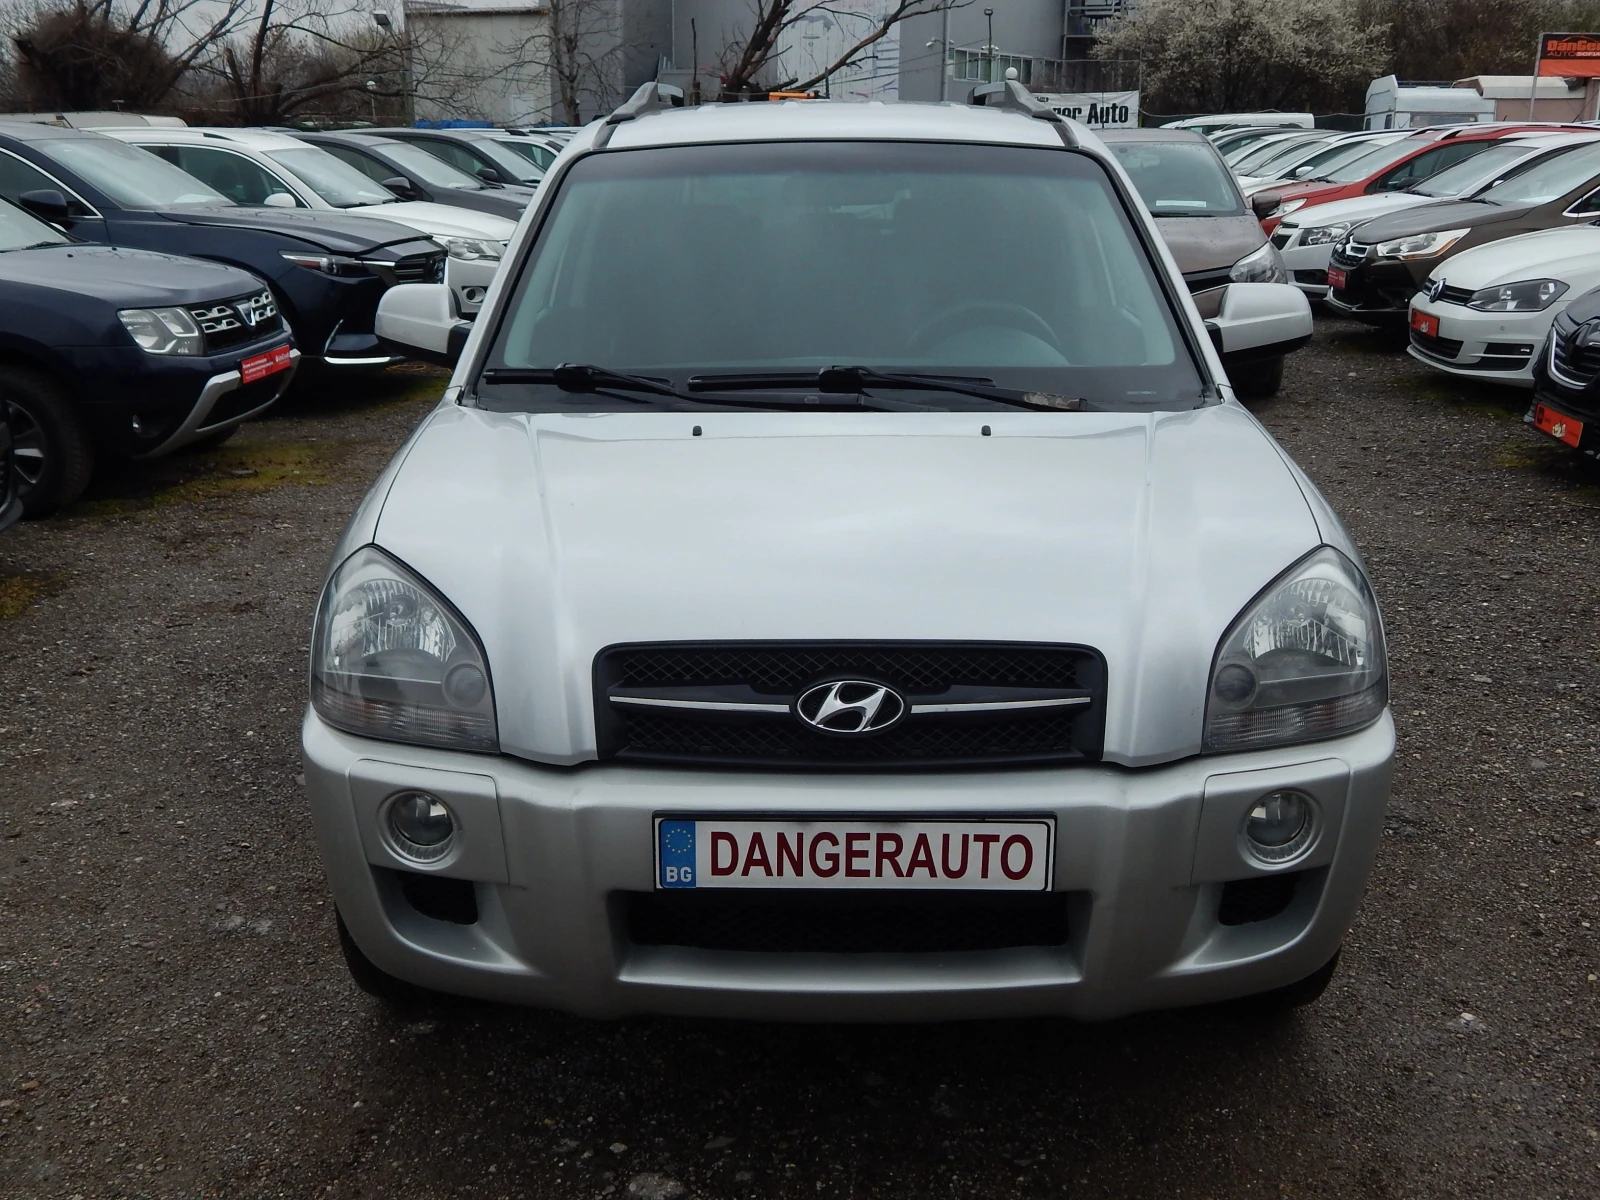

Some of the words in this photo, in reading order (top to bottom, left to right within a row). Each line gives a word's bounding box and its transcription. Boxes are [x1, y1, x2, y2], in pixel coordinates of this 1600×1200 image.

[1087, 102, 1129, 124] Auto
[710, 831, 1034, 881] DANGERAUTO
[666, 866, 692, 883] BG
